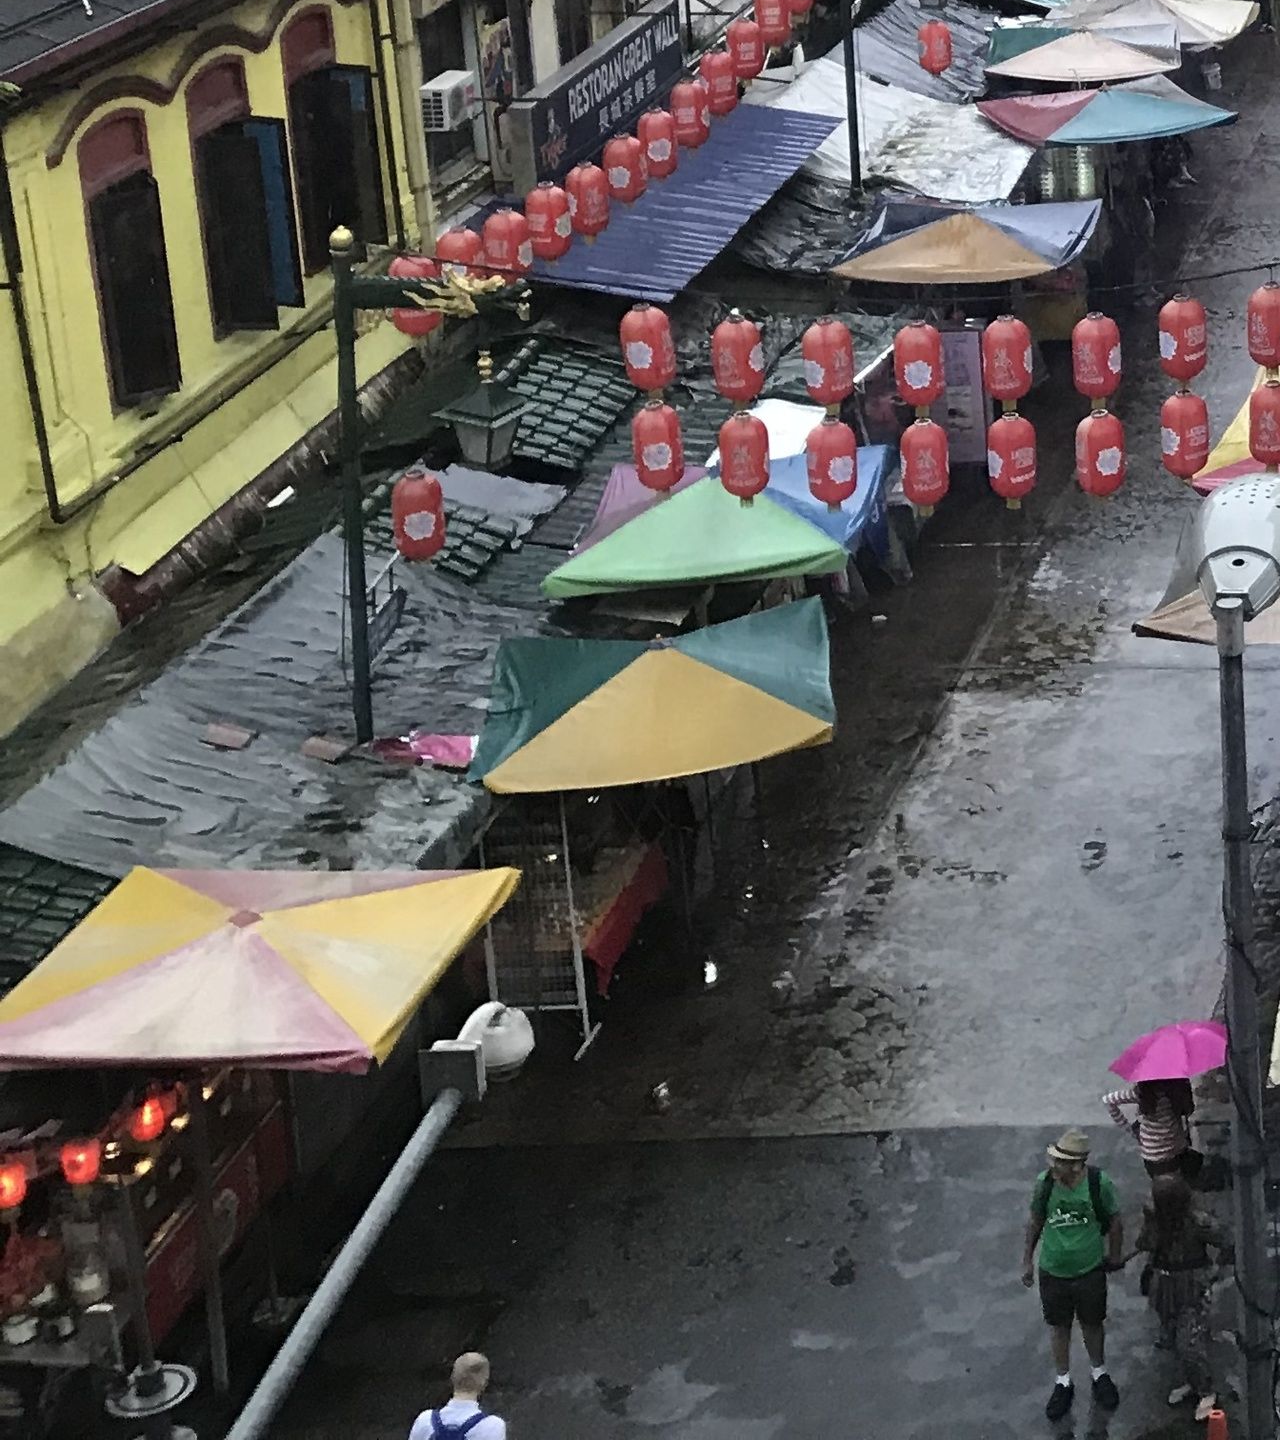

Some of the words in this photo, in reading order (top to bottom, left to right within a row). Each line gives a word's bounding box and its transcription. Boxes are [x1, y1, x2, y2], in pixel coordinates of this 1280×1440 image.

[568, 52, 622, 123] RESTORAN
[623, 29, 652, 80] GREAT
[653, 15, 678, 53] WALL
